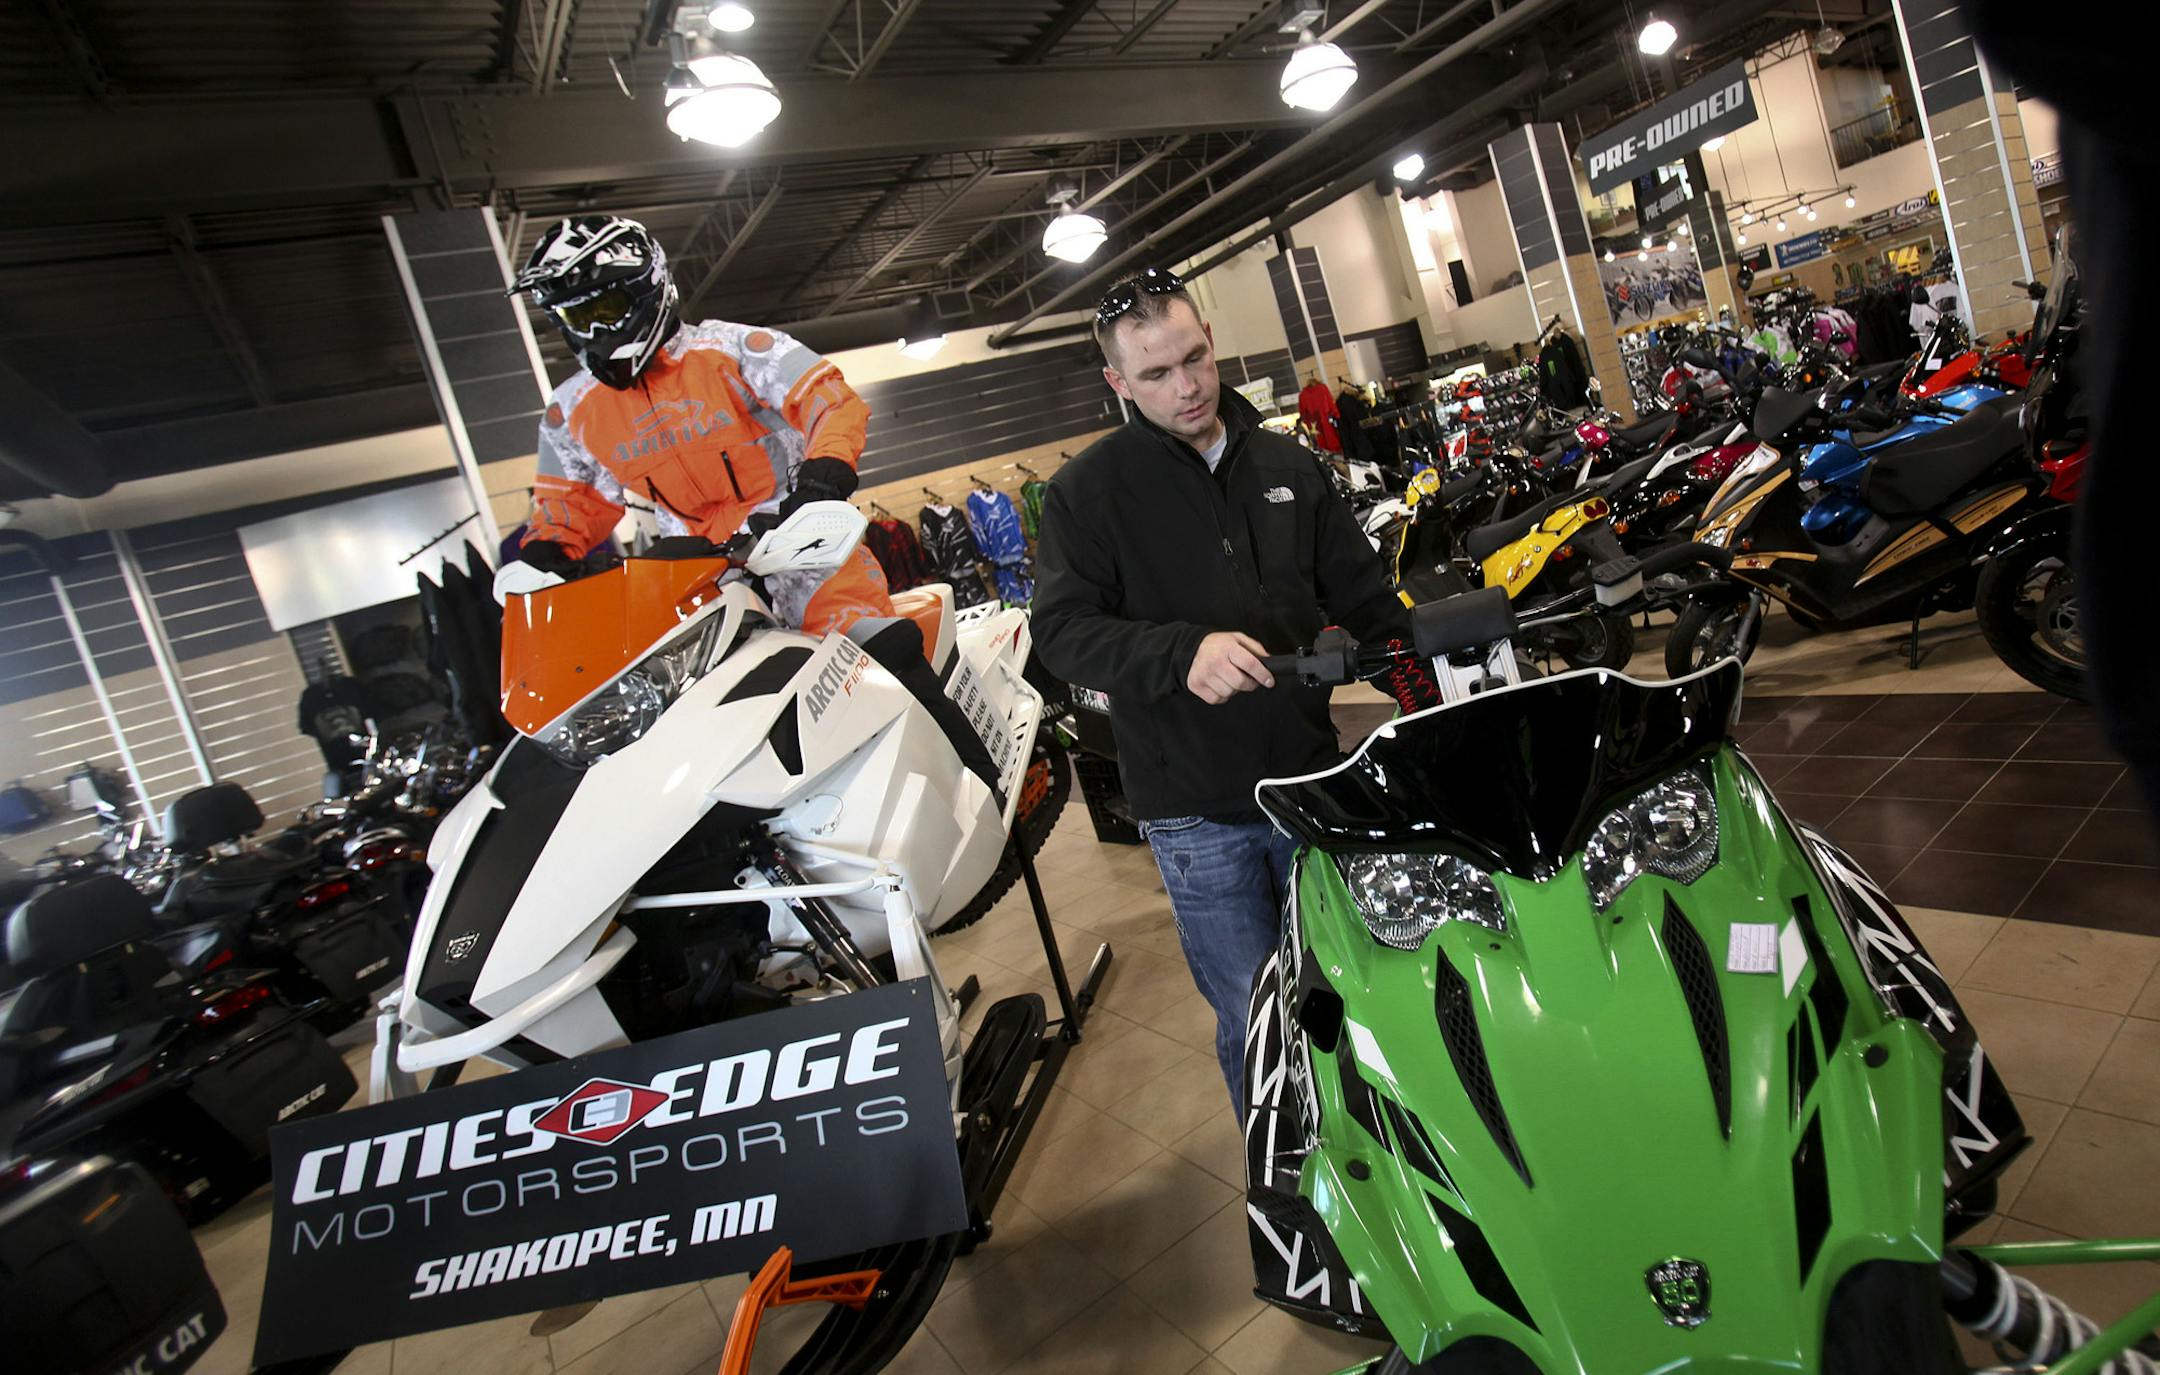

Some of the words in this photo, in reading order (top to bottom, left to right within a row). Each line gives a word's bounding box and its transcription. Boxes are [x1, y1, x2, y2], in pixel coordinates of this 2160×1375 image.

[1589, 79, 1744, 180] PRE-OWNED
[804, 656, 848, 723] ARCTIC
[836, 638, 860, 666] CAT
[963, 685, 979, 716] SAFETY
[972, 697, 988, 730] PLEASE
[292, 1097, 560, 1205] CITIES
[643, 1017, 910, 1128] EDGE
[293, 1095, 909, 1255] MOTORSPORTS
[409, 1214, 678, 1300] SHAKOPEE,
[690, 1193, 777, 1245] MN
[158, 1312, 206, 1362] CAT
